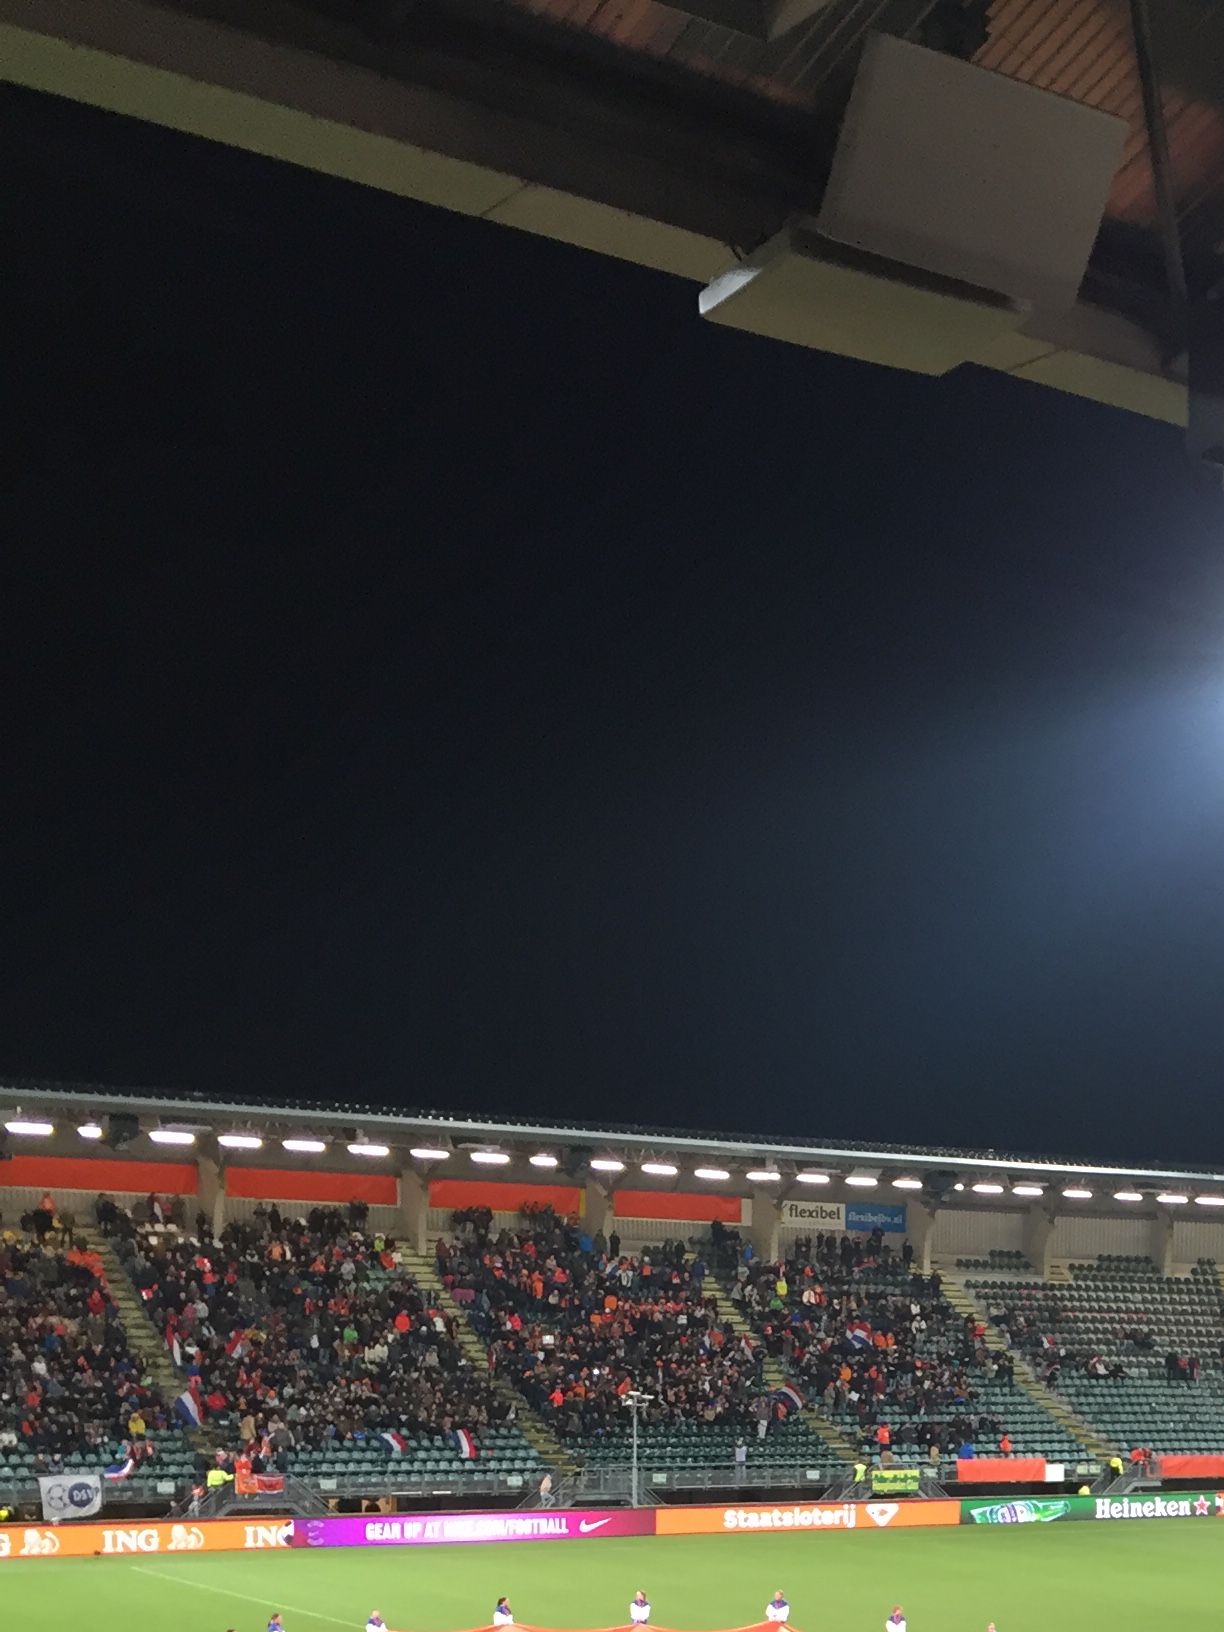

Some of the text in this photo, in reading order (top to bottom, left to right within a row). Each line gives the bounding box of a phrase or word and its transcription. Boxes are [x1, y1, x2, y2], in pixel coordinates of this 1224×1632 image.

[789, 1204, 841, 1220] flexibel
[724, 1504, 856, 1528] Staatsloterij
[1096, 1497, 1191, 1518] Heineken
[103, 1529, 160, 1552] ING
[366, 1522, 400, 1540] GEAR
[404, 1521, 421, 1539] UP
[424, 1520, 441, 1538] AT
